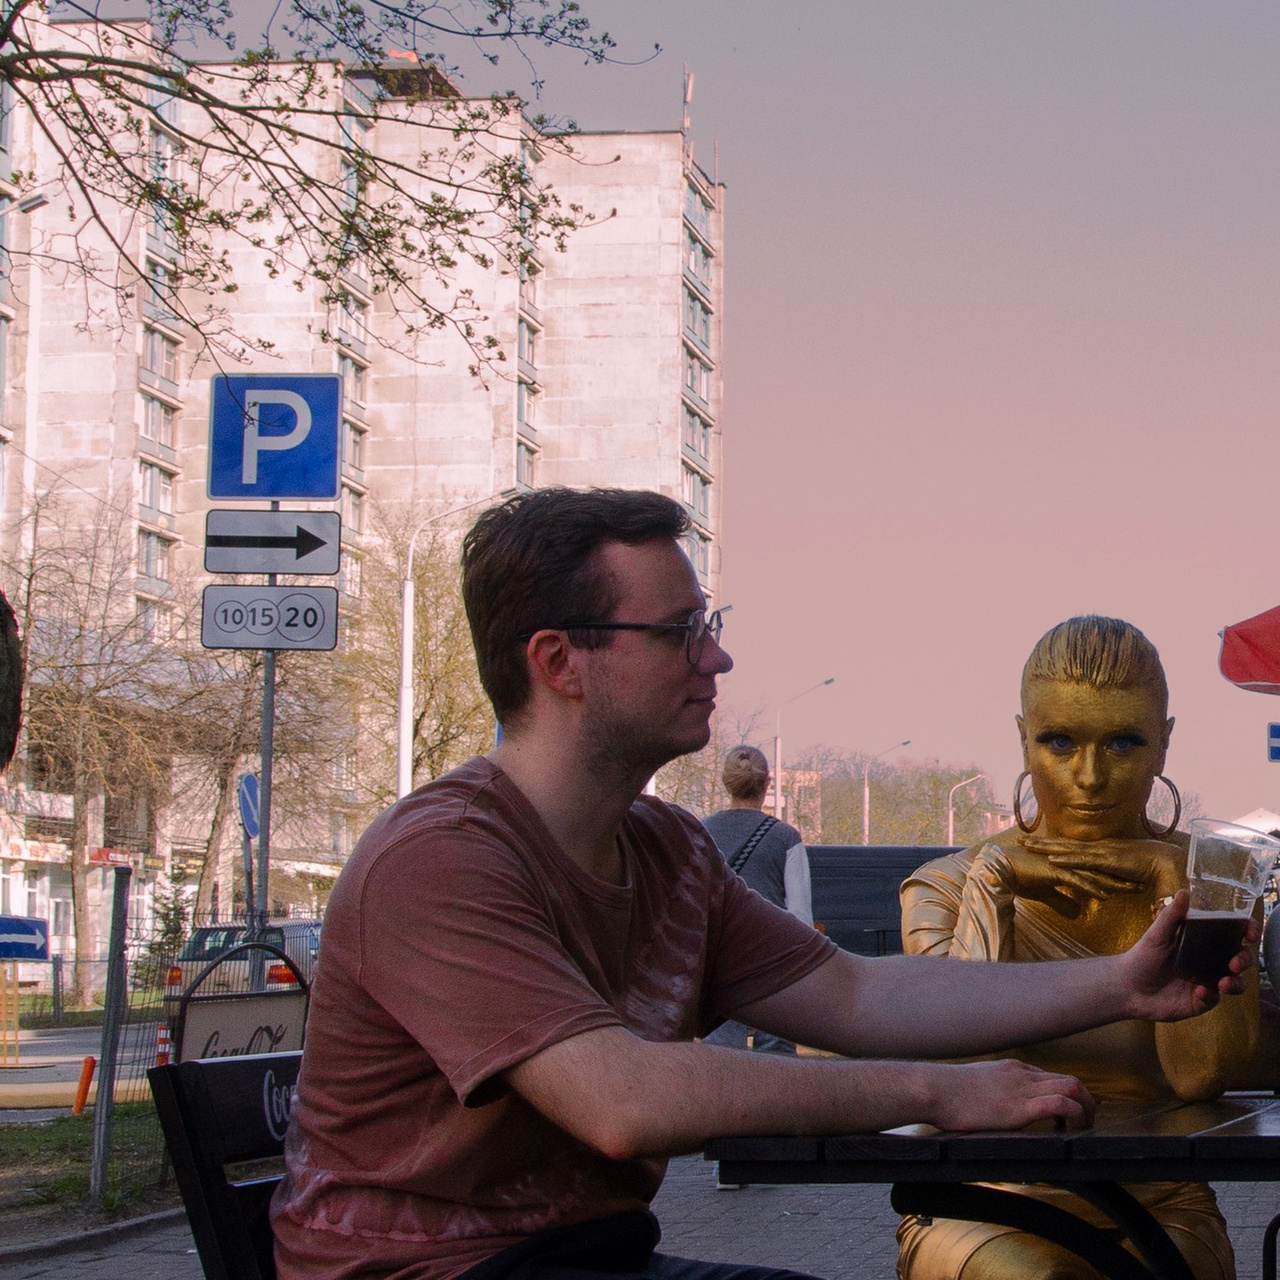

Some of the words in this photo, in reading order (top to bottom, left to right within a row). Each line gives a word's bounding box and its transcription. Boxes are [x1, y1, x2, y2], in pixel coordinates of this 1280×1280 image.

[221, 608, 244, 626] 10
[249, 607, 274, 627] 15
[285, 607, 318, 629] 20
